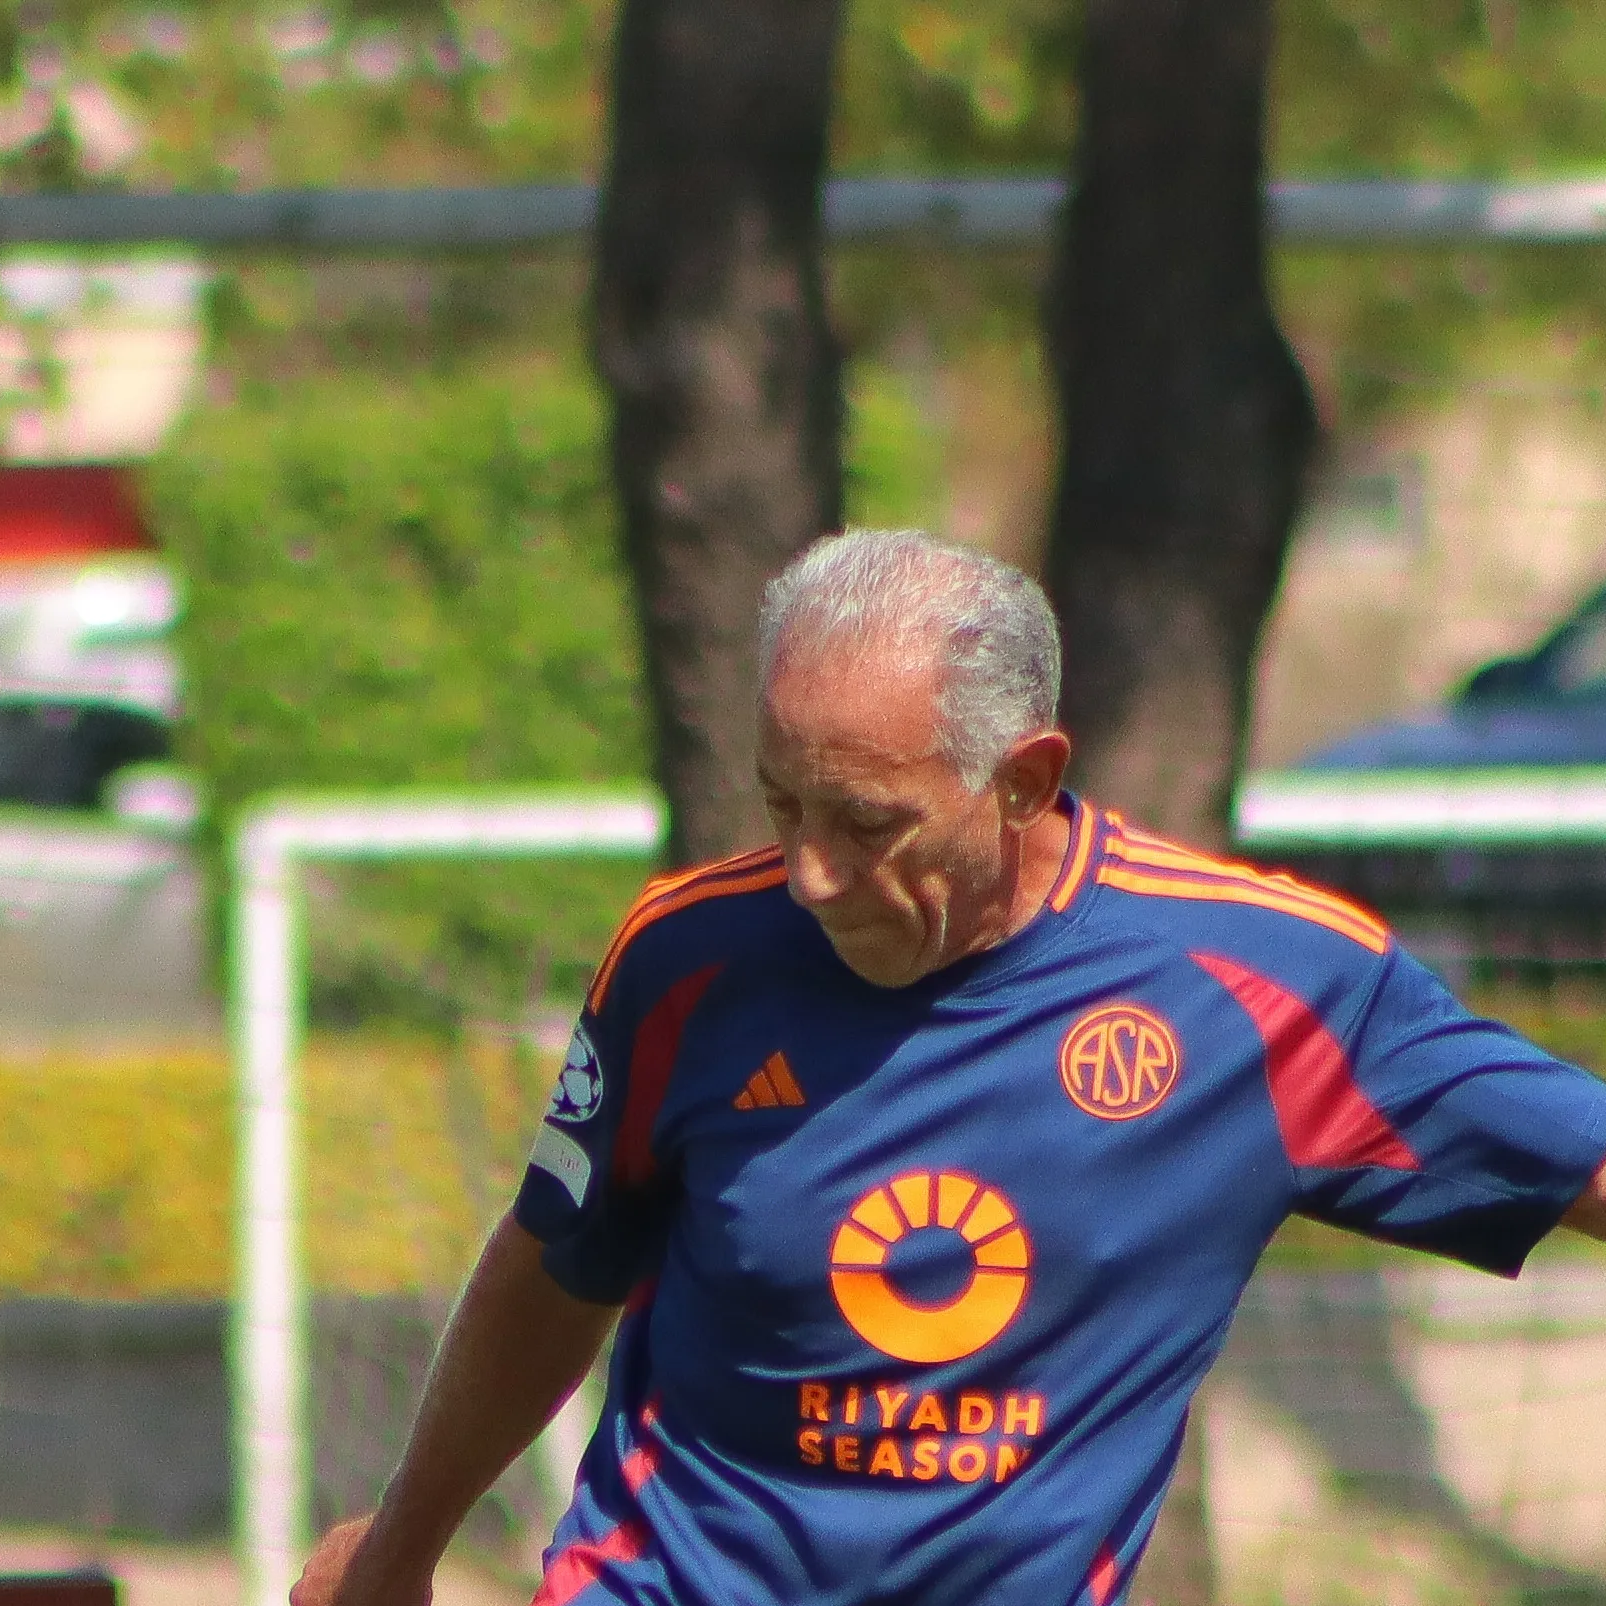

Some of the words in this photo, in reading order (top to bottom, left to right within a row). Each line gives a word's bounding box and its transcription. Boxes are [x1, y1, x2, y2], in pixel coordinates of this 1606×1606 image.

[1070, 1019, 1168, 1107] ASR
[799, 1383, 1042, 1436] RIYADH
[798, 1430, 1032, 1484] SEASON
